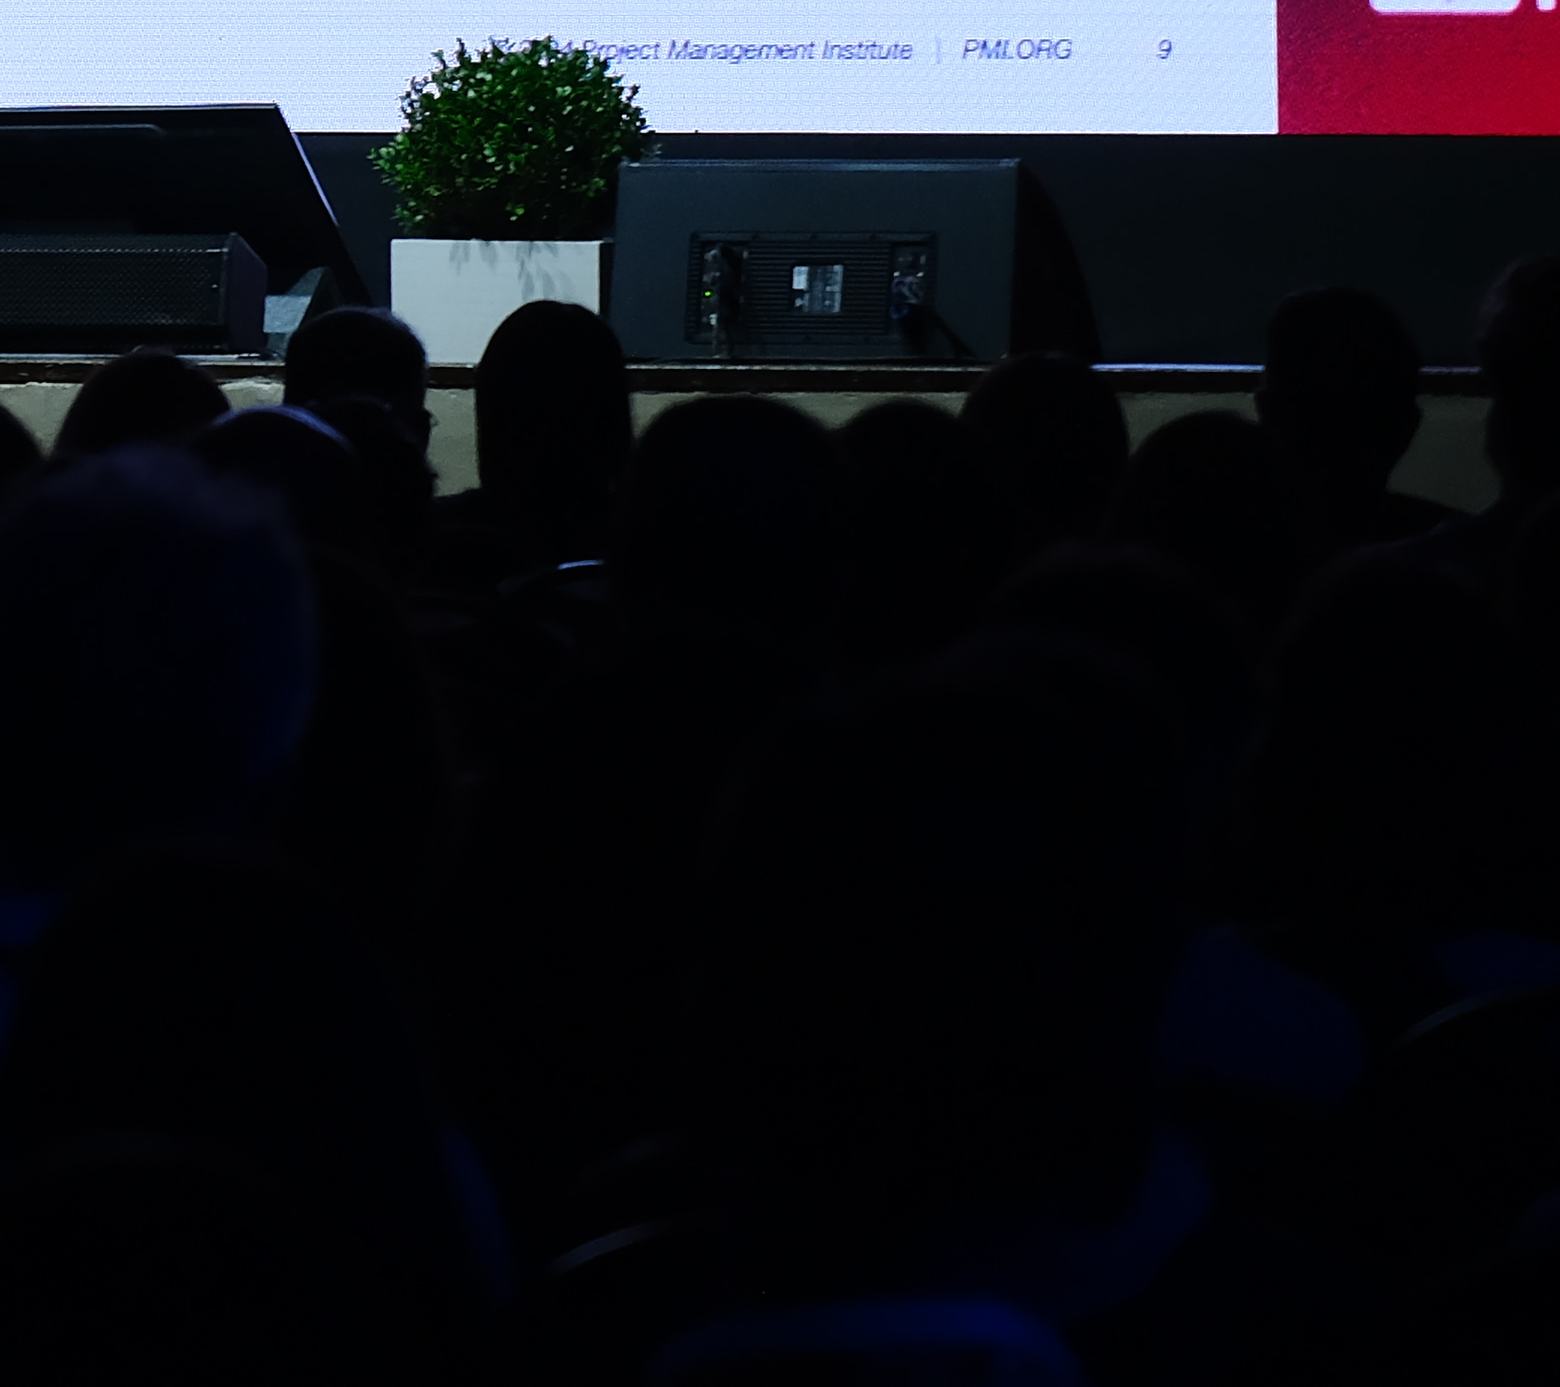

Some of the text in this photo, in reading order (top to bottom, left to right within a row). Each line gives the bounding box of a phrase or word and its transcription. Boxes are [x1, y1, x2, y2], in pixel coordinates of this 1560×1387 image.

[668, 40, 815, 64] Management
[823, 41, 912, 60] Institute
[1160, 40, 1172, 59] 9
